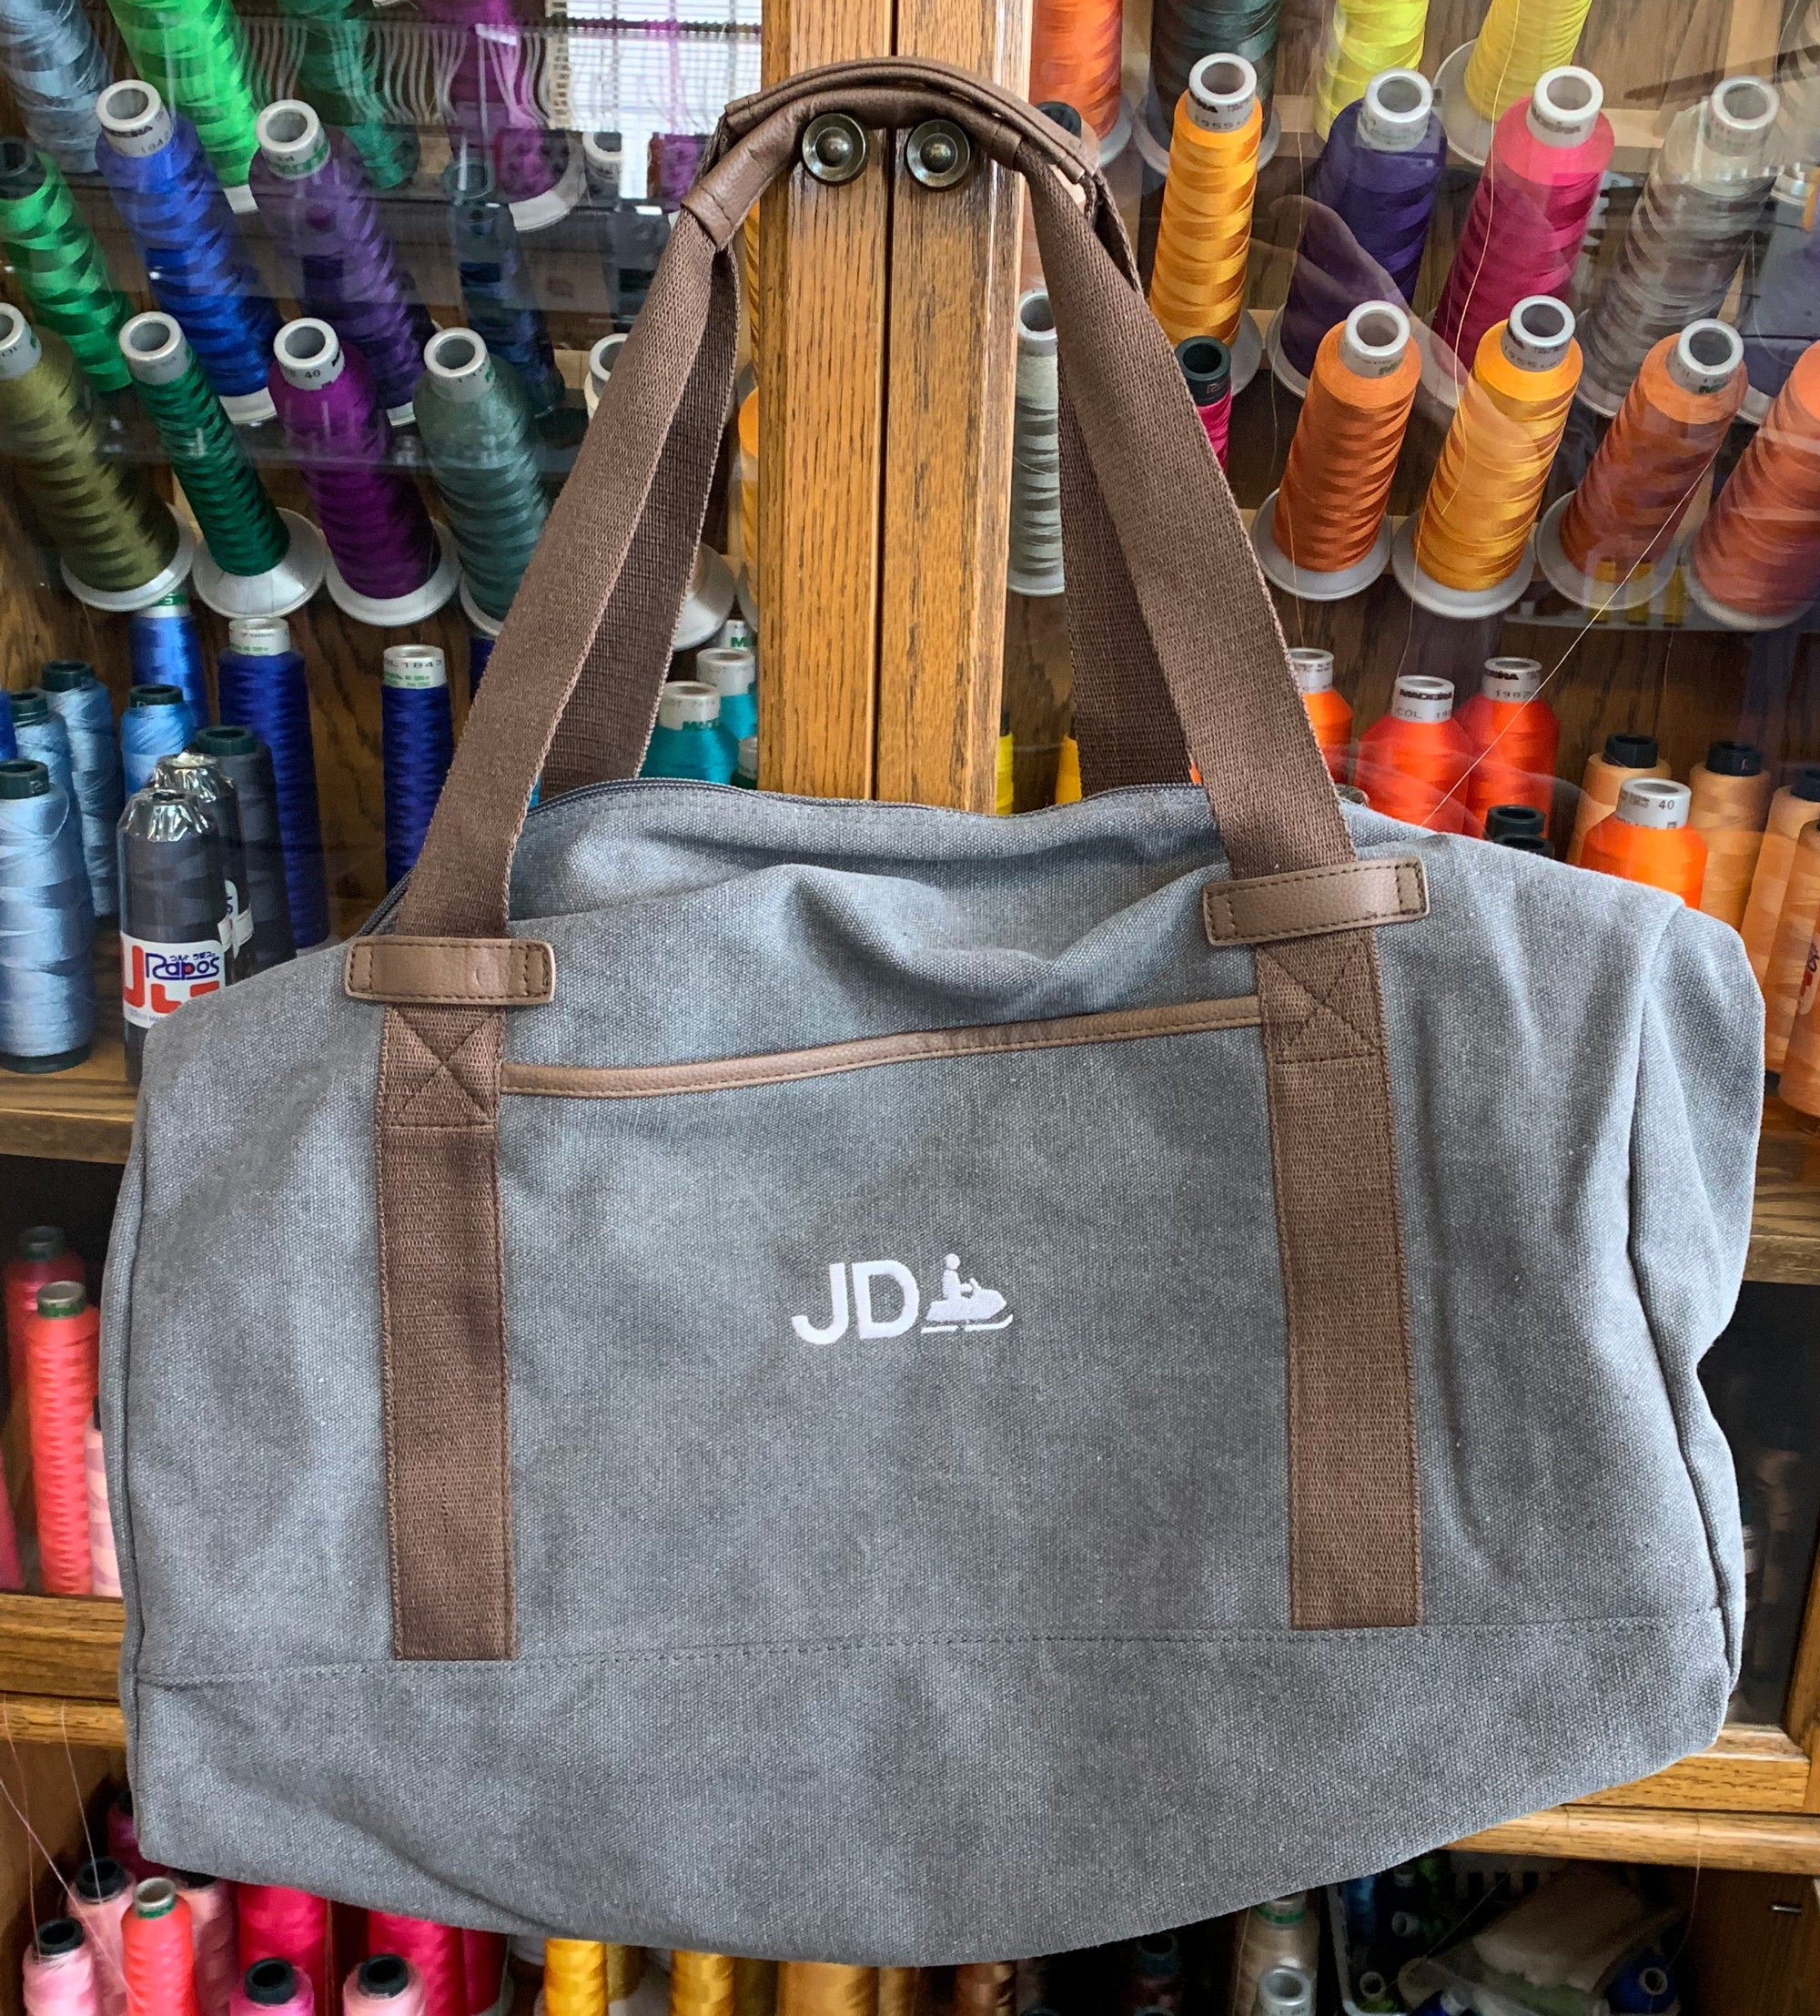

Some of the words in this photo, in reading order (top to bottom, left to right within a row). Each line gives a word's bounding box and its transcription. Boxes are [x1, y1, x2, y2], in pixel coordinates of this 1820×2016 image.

[305, 369, 321, 379] 40
[1658, 799, 1675, 811] 40
[791, 1259, 921, 1345] JD
